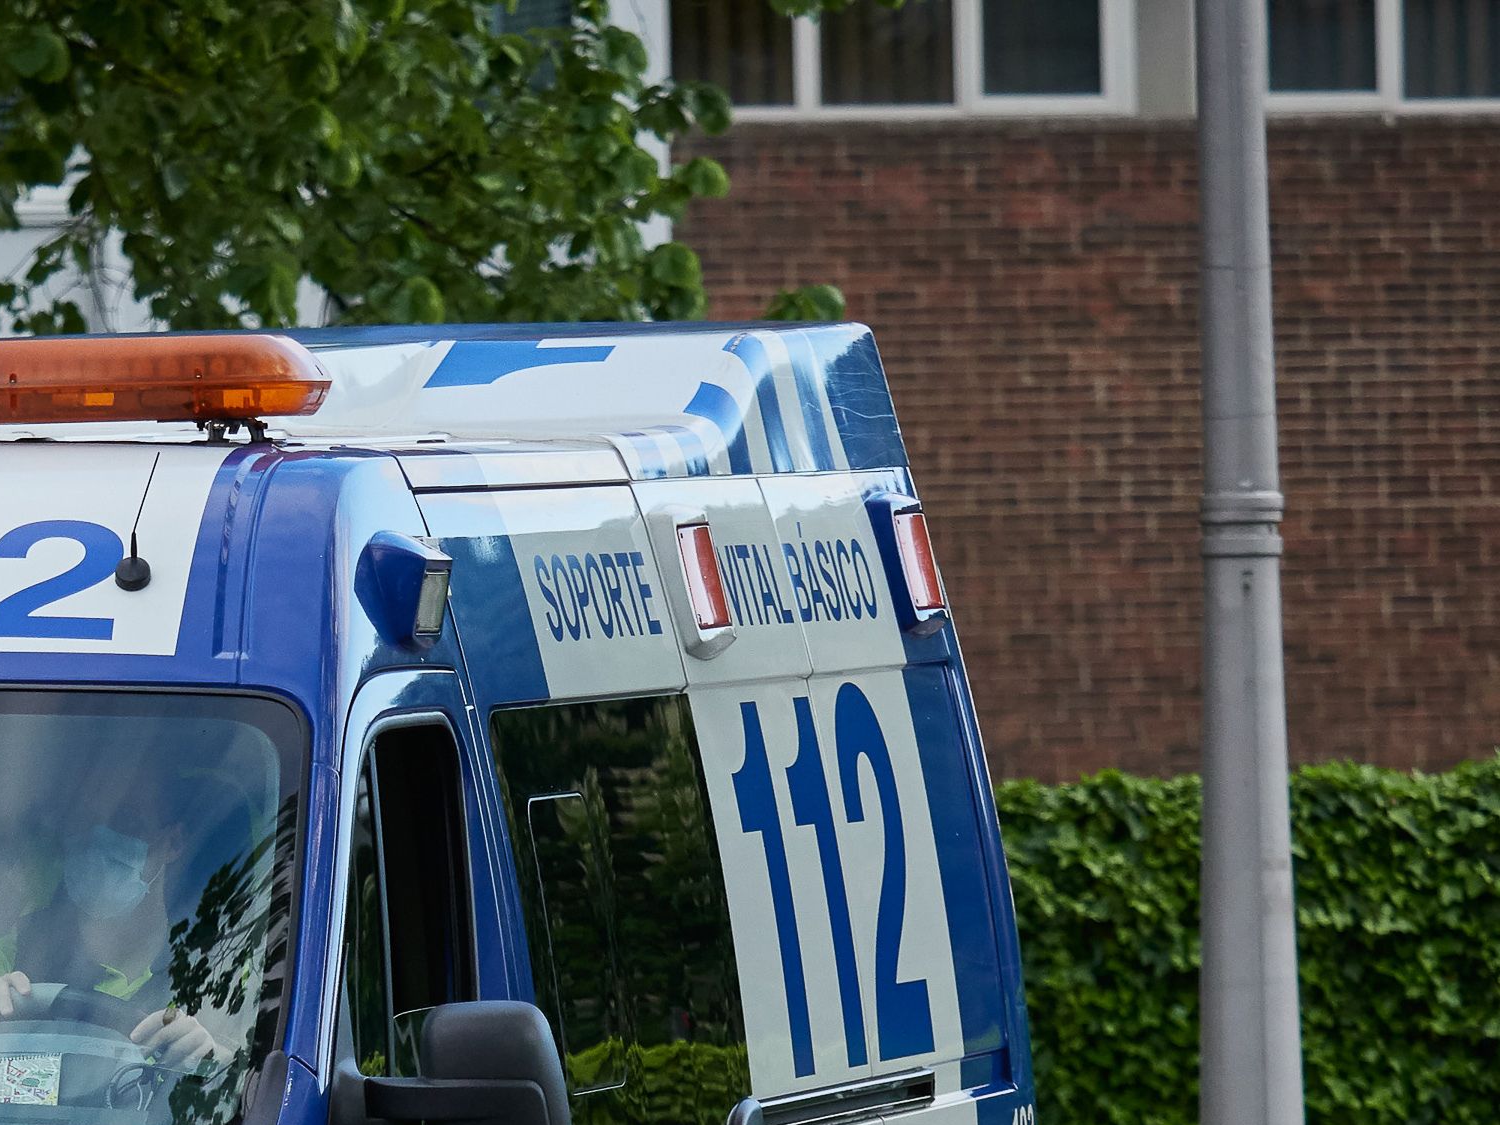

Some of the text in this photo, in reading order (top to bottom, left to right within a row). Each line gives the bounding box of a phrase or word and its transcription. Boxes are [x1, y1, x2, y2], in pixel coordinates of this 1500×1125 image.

[534, 551, 662, 642] SOPORTE
[716, 544, 794, 626] VITAL
[731, 681, 936, 1078] 112
